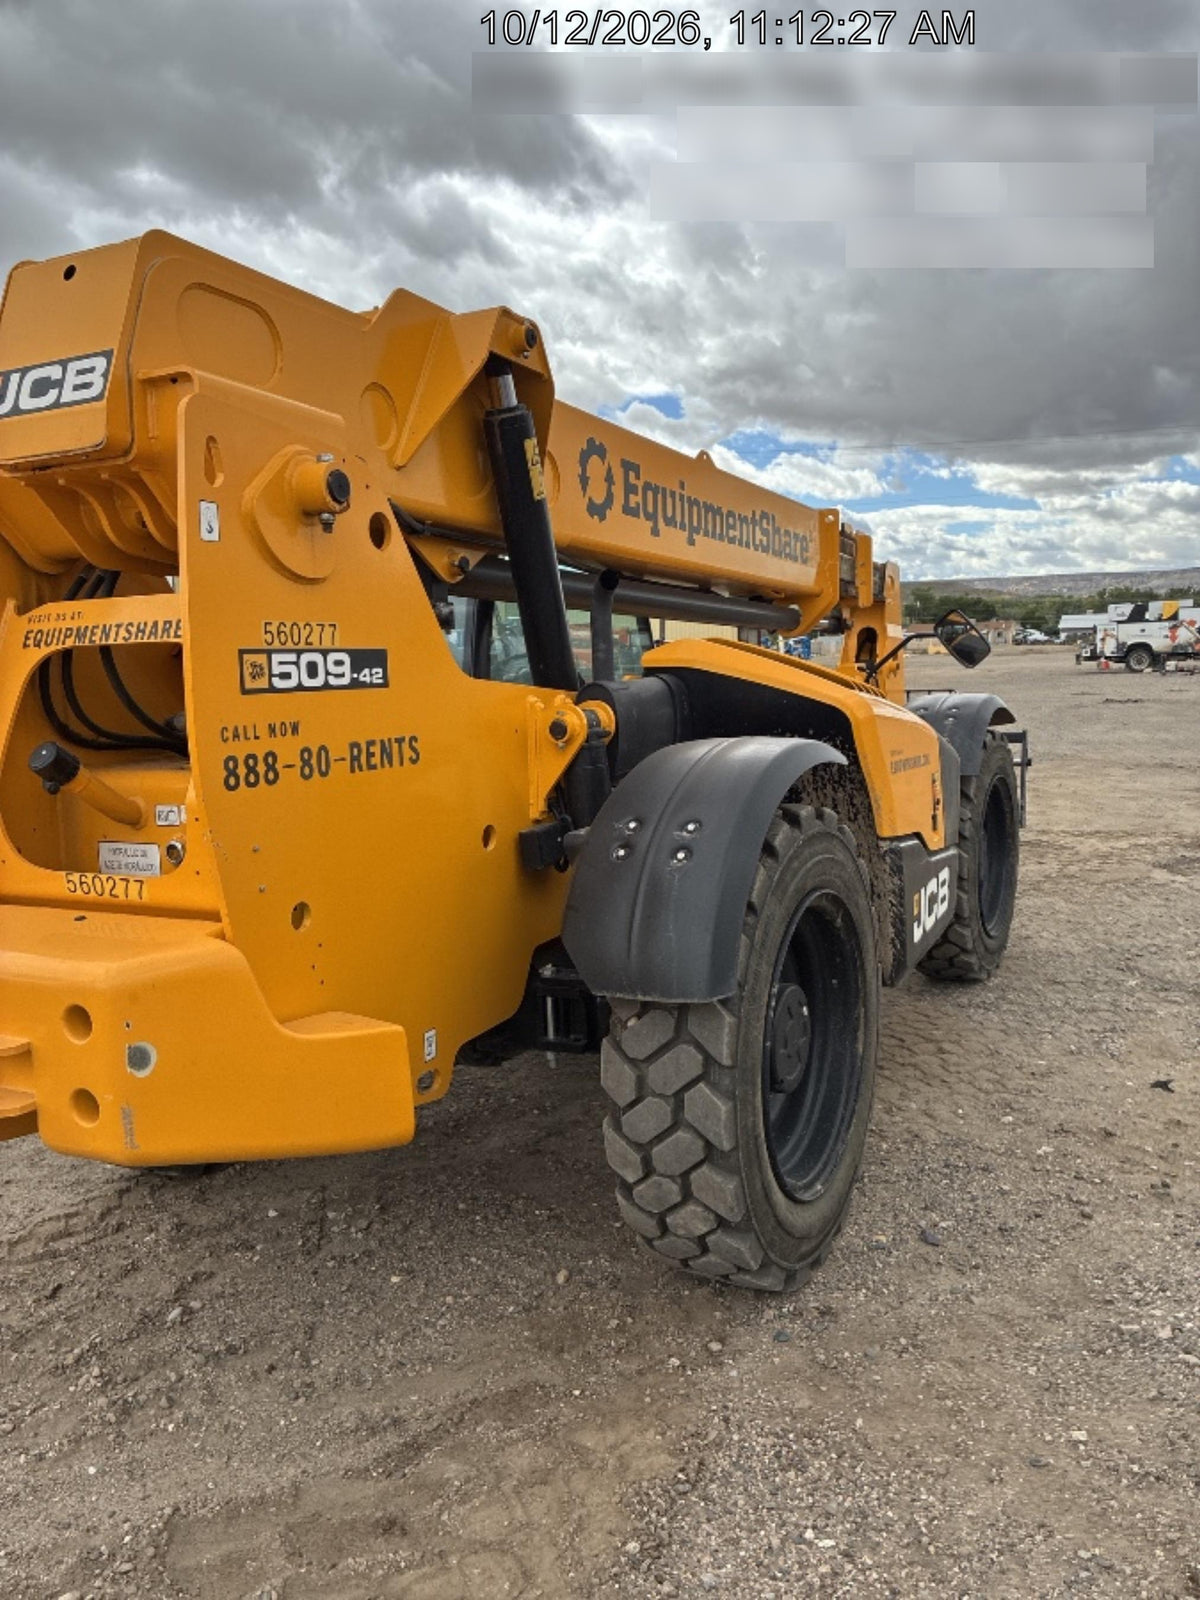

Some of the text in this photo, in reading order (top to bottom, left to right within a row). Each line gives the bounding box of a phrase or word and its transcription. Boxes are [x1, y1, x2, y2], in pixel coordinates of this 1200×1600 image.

[620, 457, 810, 565] EquipmentShare
[22, 618, 182, 649] EQUIPMENTSHARE
[264, 621, 338, 646] 560277
[221, 720, 300, 743] CALL NOW
[223, 735, 420, 792] 888-80-RENTS
[65, 872, 145, 900] 560277
[913, 866, 950, 943] JCB
